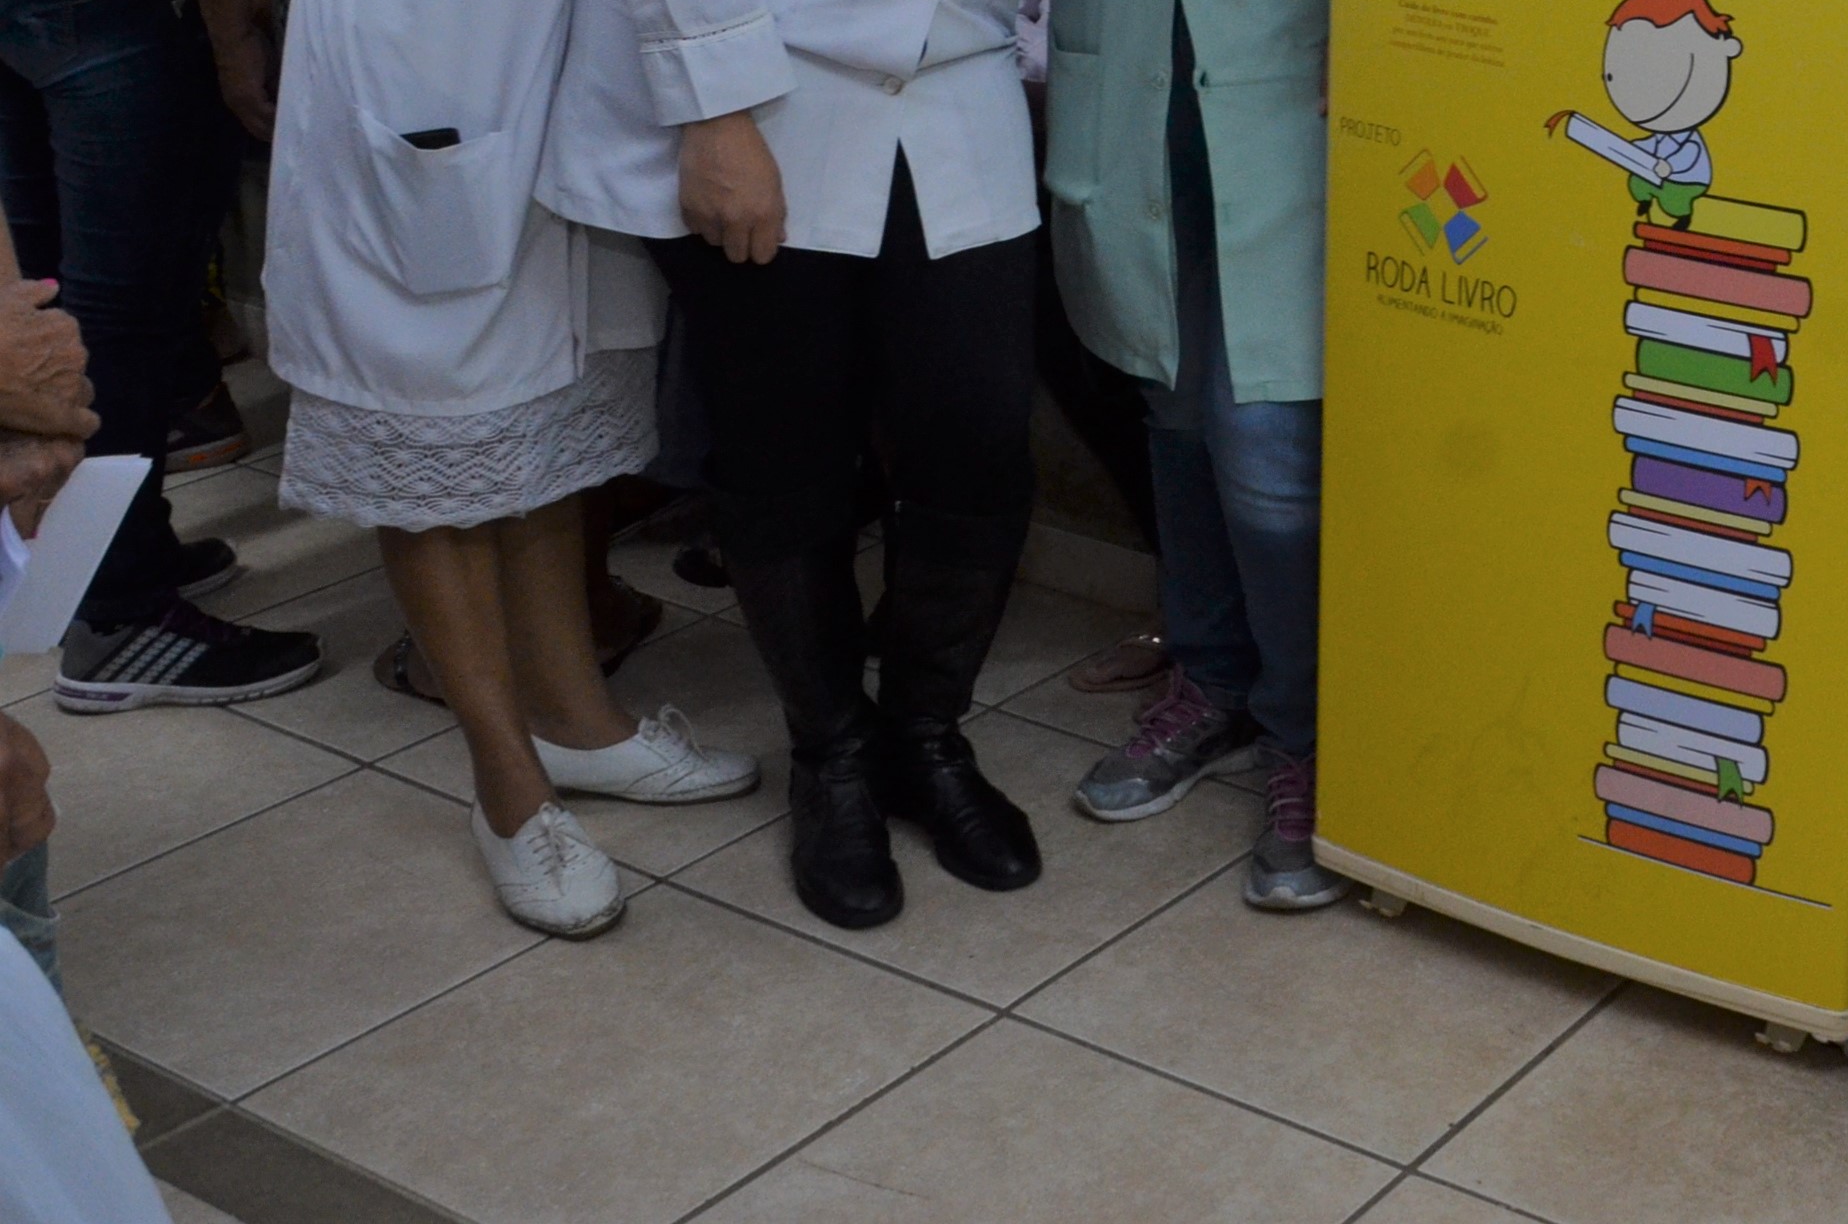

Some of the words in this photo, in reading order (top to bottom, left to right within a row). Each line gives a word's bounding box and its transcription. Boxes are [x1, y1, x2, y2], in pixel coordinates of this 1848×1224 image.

[1339, 116, 1402, 147] PROJETO
[1366, 250, 1431, 298] RODA
[1441, 271, 1517, 318] LIVRO
